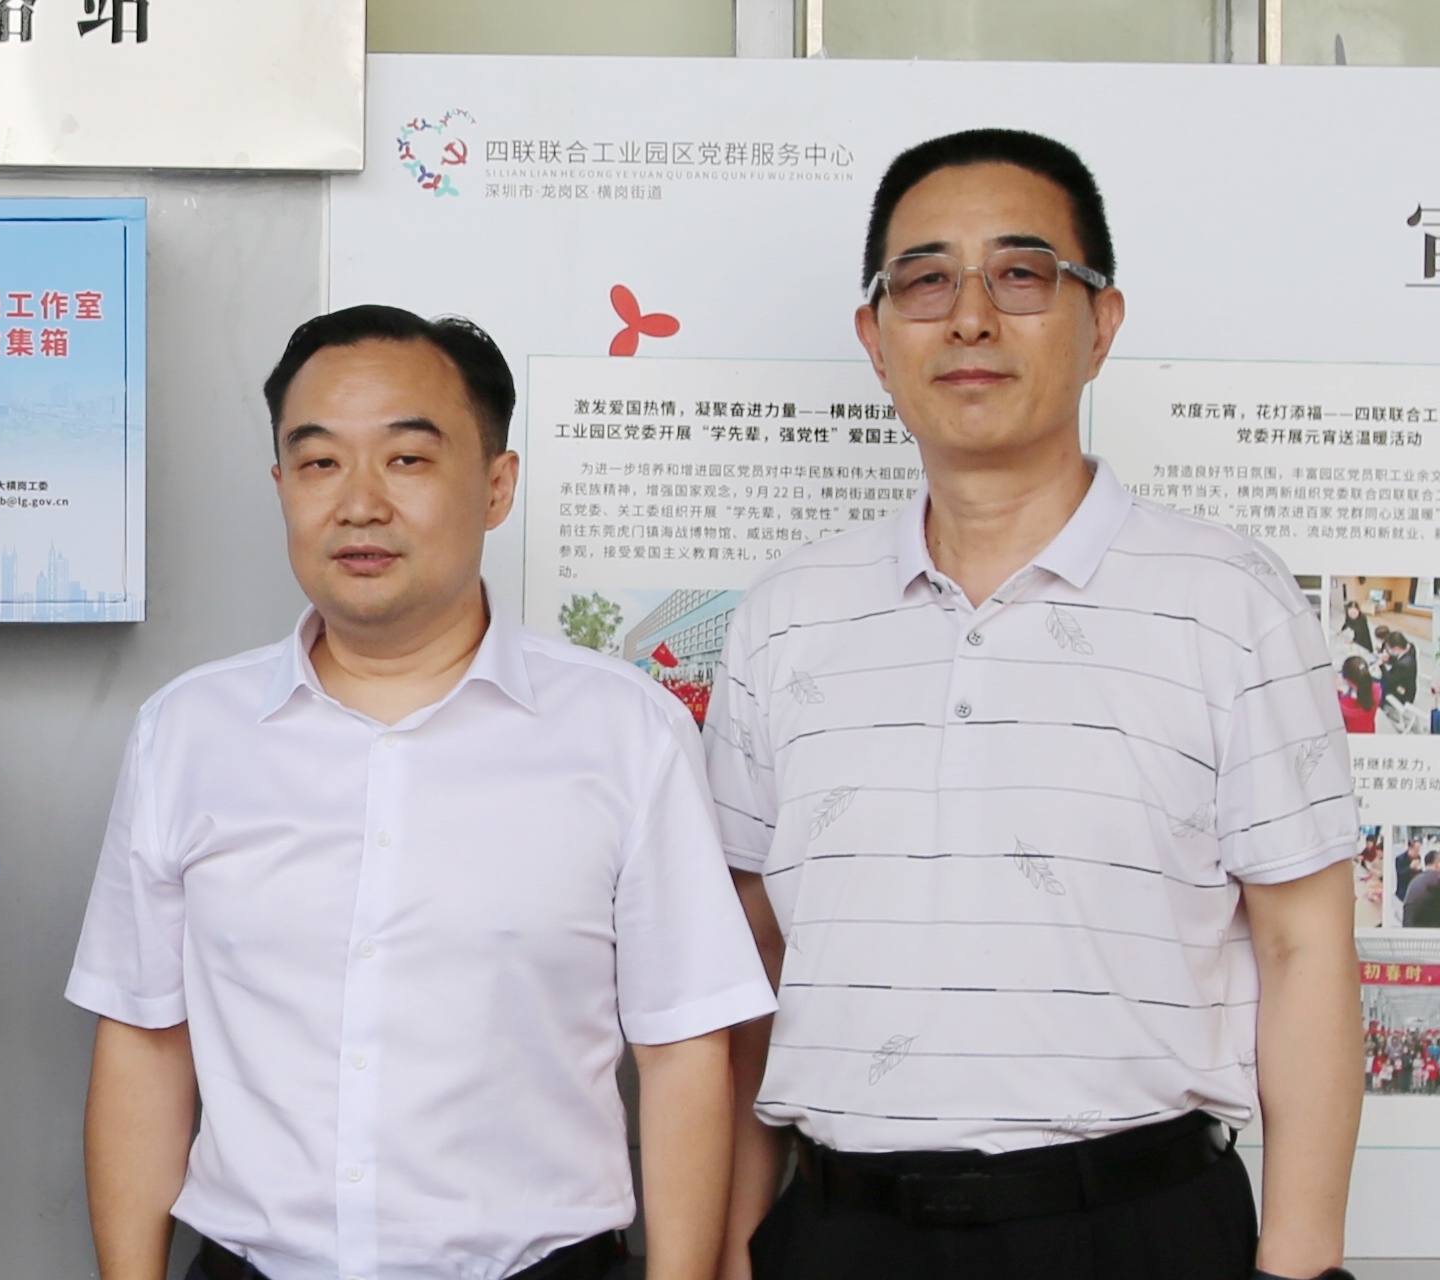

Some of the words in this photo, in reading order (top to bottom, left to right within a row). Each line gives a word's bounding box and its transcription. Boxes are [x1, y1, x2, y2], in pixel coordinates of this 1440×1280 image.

[485, 140, 854, 167] 四联联合工业园区党群服务中心
[486, 169, 496, 177] SI
[499, 169, 526, 178] LIAN
[530, 169, 557, 178] LIAN
[561, 170, 575, 178] HE
[579, 170, 612, 179] GONG
[616, 170, 629, 179] YE
[632, 170, 663, 179] YUAN
[667, 171, 683, 179] QU
[687, 171, 719, 180] DANG
[721, 171, 746, 180] QUN
[750, 172, 765, 180] FU
[768, 172, 786, 180] WU
[789, 172, 830, 181] ZHONG
[834, 172, 853, 181] XIN
[485, 184, 662, 201] 深圳市·龙岗区·横岗街道
[556, 424, 918, 444] 工业园区党委开展“学先辈，强党性”爱国主义
[1237, 428, 1422, 446] 党委开展元宵送温暖活动
[560, 503, 898, 521] 区党委、关工委组织开展“学先辈，强党性”爱国主
[559, 566, 577, 578] 动。
